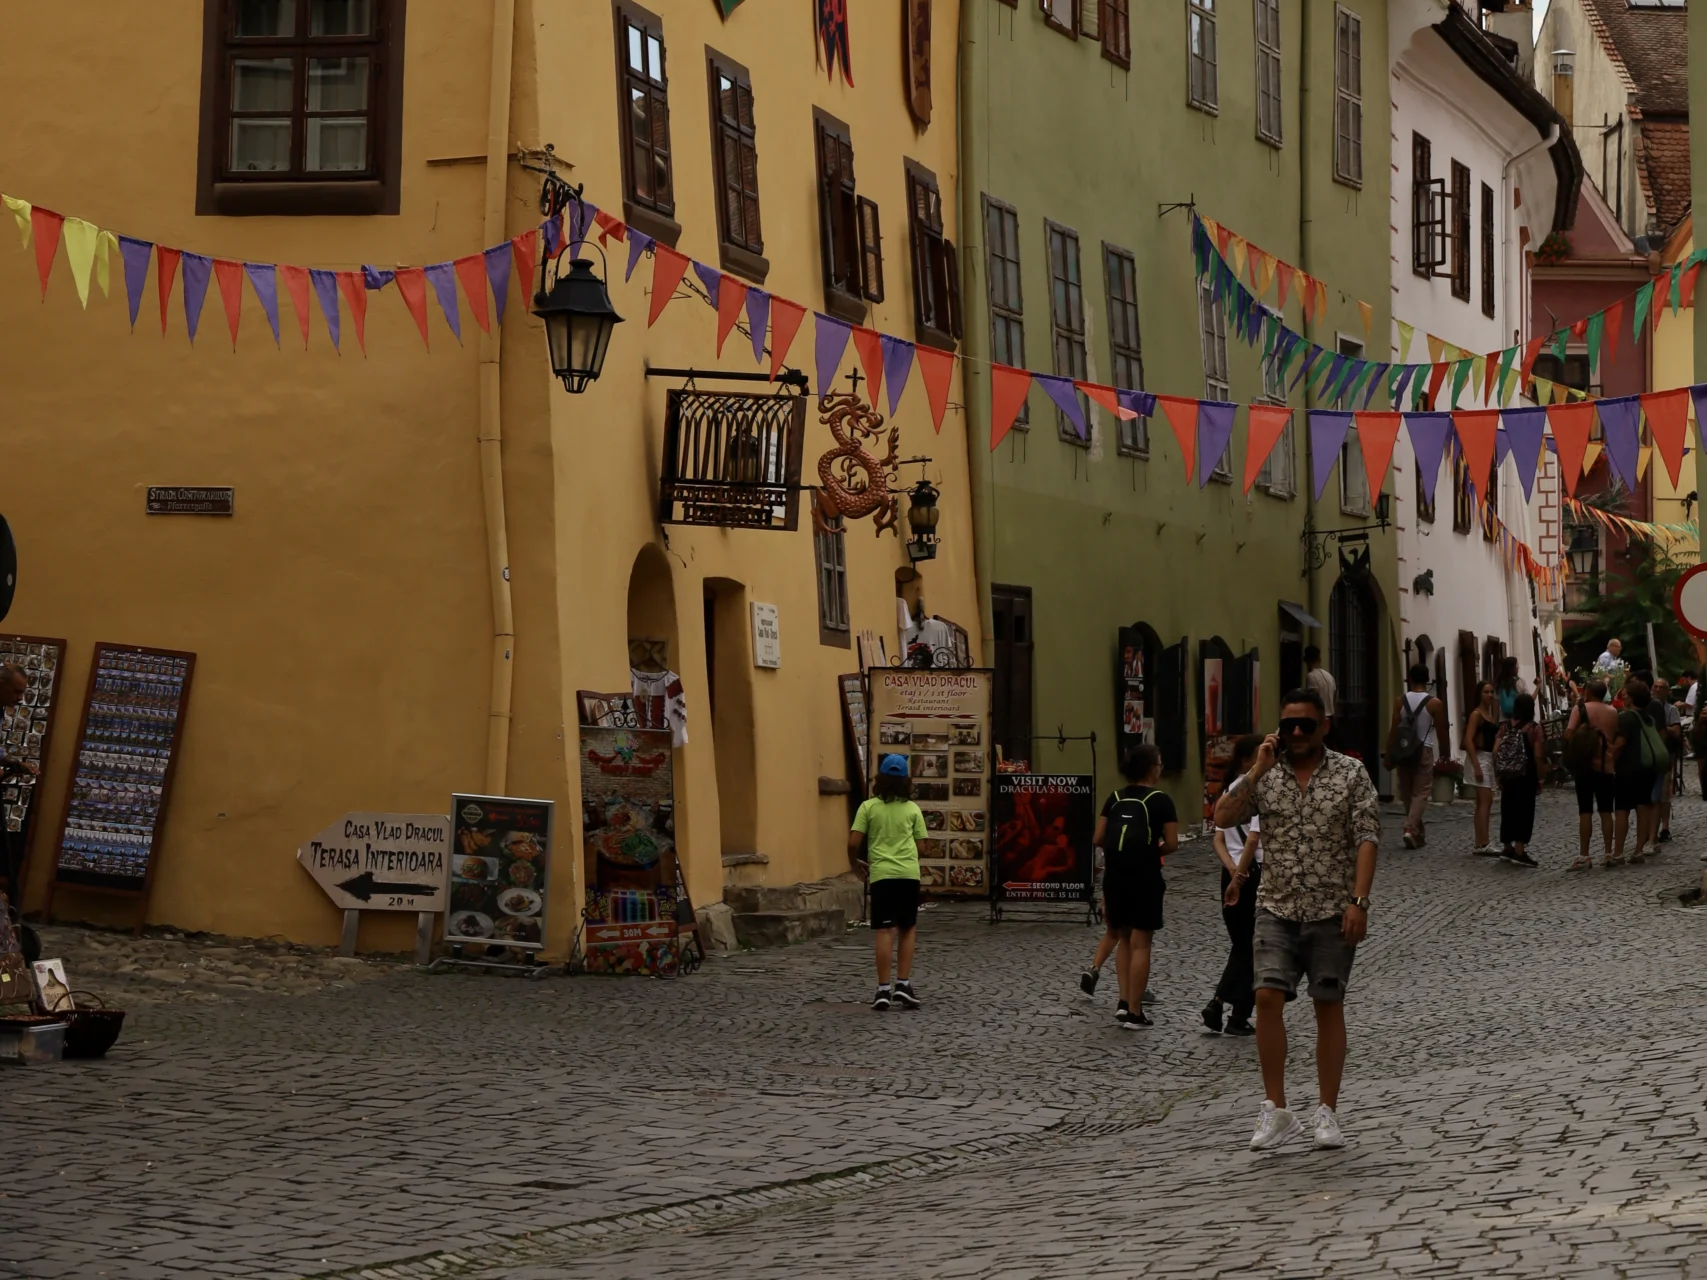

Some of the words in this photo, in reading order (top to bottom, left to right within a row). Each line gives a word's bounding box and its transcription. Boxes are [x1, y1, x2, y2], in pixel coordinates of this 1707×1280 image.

[150, 488, 177, 500] STRADA
[884, 675, 909, 687] CASA
[912, 676, 937, 687] VLAD
[940, 676, 978, 688] DRACUL
[900, 689, 916, 697] etaj
[945, 689, 968, 698] floor
[1011, 776, 1045, 785] VISIT
[1048, 776, 1078, 785] NOW
[1000, 785, 1055, 794] DRACULA'S
[1057, 785, 1090, 794] ROOM
[1062, 882, 1085, 890] FLOOR
[388, 896, 403, 907] 20
[622, 928, 642, 938] 30M
